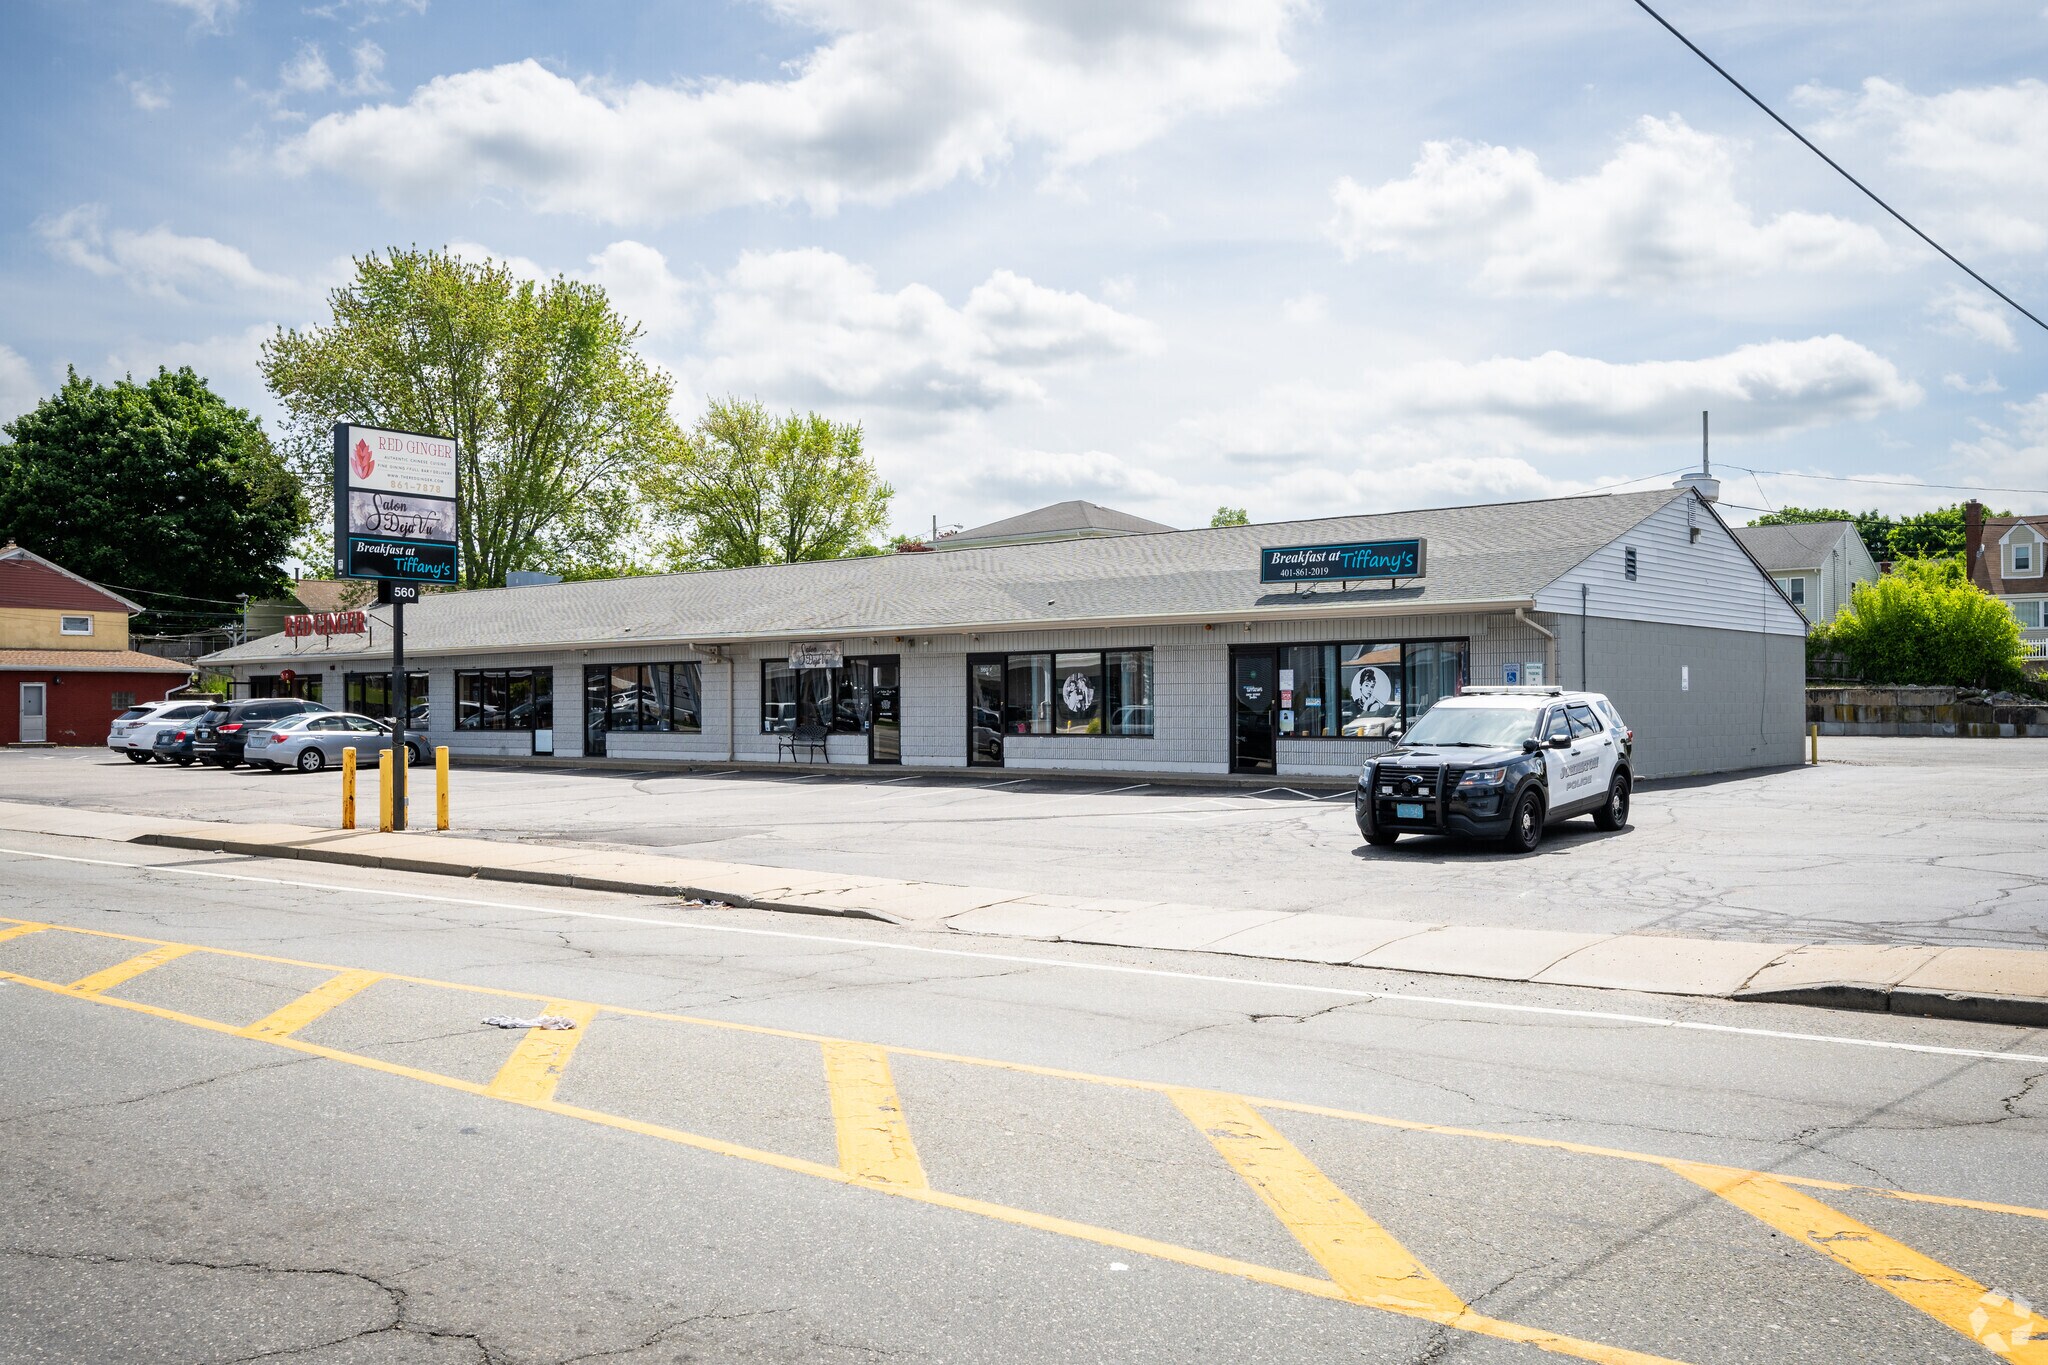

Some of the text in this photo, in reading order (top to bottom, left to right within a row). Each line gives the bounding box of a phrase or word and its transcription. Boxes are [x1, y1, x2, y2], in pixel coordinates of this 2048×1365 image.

[378, 436, 452, 459] RED GINGER
[390, 480, 441, 493] 861-7878
[366, 493, 407, 531] Salon
[384, 510, 437, 538] Deja Vu
[356, 542, 416, 557] Breakfast at
[393, 557, 451, 579] Tiffany's
[1271, 549, 1414, 573] Breakfast at Tiffany's
[1280, 567, 1329, 577] 401-861-2019
[394, 587, 415, 598] 560
[284, 611, 367, 637] RED GINGER
[1566, 774, 1592, 792] POLICE
